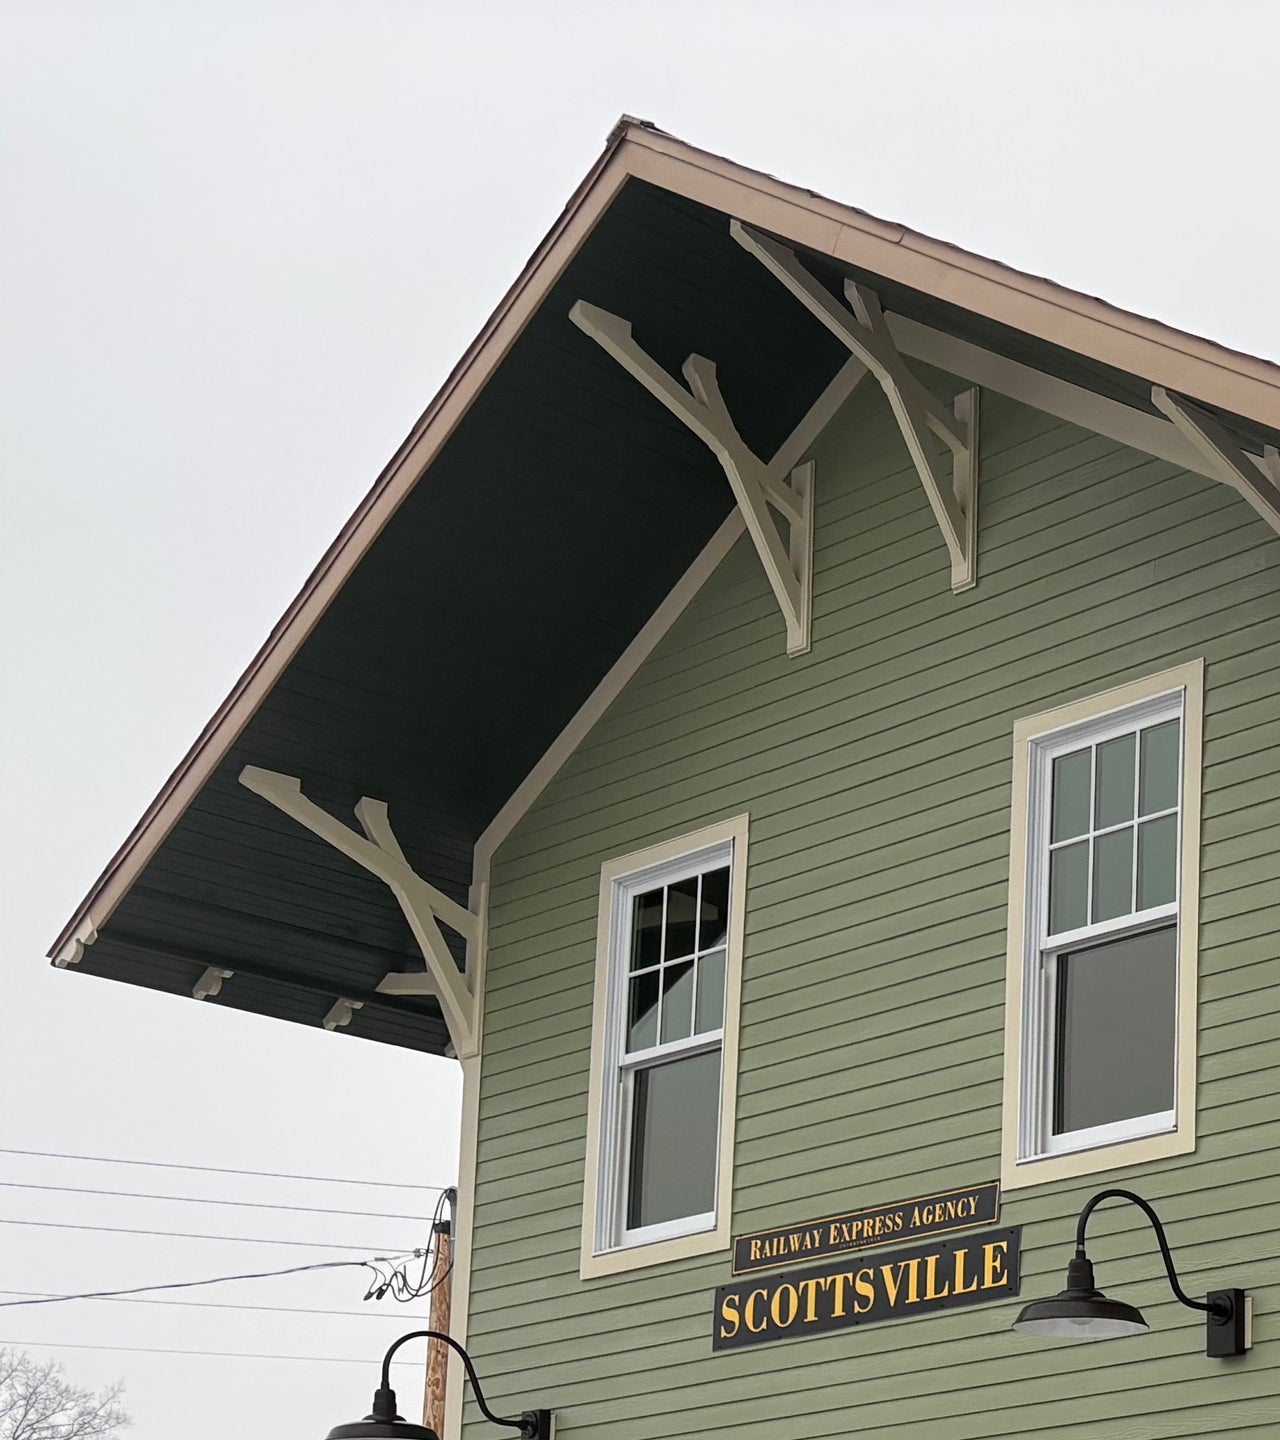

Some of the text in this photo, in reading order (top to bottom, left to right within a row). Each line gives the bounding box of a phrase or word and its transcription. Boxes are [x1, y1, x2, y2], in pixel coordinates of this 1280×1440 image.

[750, 1196, 979, 1261] RAILWAY EXPRESS AGENCY
[720, 1241, 1009, 1338] SCOTTSVILLE
